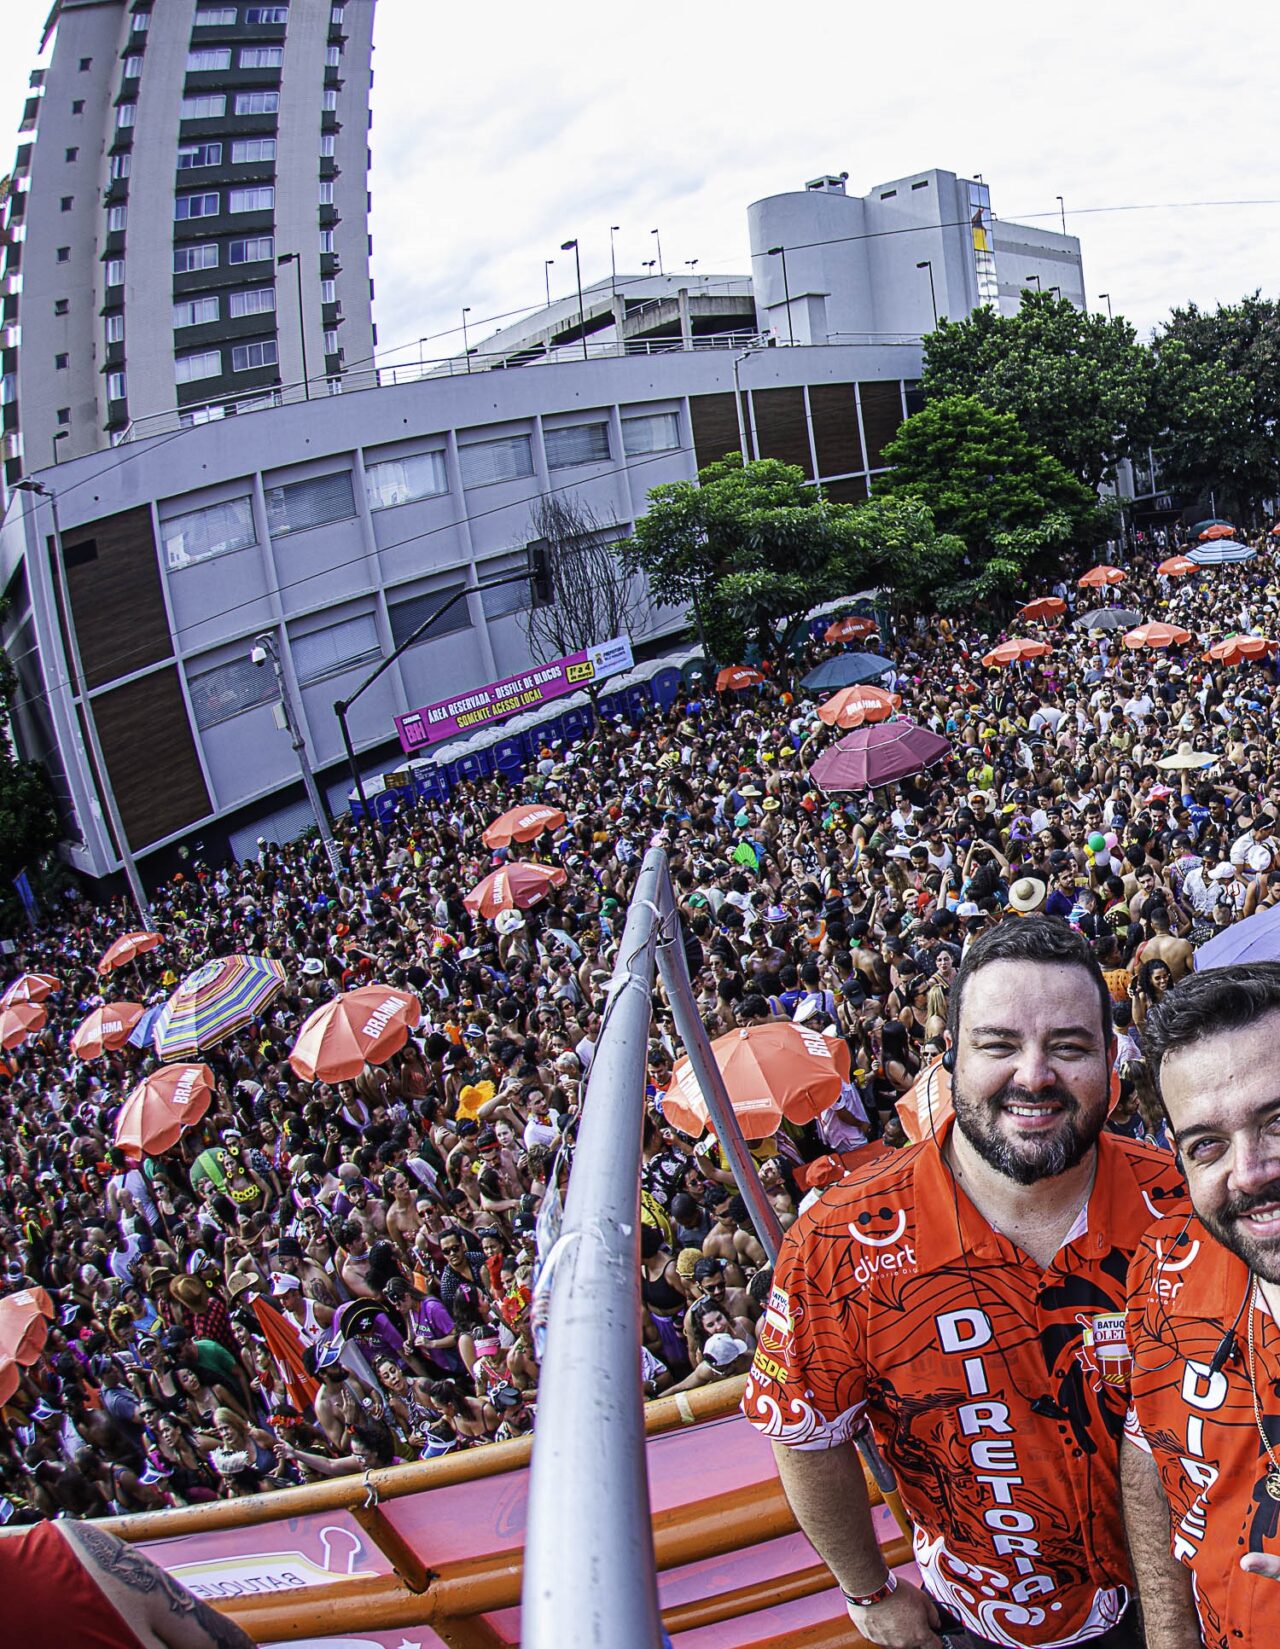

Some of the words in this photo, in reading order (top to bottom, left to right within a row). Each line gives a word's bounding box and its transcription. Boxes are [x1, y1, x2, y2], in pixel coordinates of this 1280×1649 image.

[584, 662, 591, 671] 4
[428, 708, 448, 724] ÁREA
[449, 691, 491, 716] RESERVADA
[495, 681, 523, 699] DESFILE
[523, 676, 534, 689] DE
[534, 666, 562, 686] BLOCOS
[456, 708, 492, 728] SOMENTE
[492, 696, 520, 716] ACESSO
[521, 687, 543, 706] LOCAL
[845, 699, 882, 715] BRAHMA
[404, 720, 427, 745] BH
[518, 809, 555, 828] BRAHMA
[855, 1244, 917, 1284] divert
[1097, 1320, 1125, 1330] BATUQ
[750, 1362, 772, 1388] 2017
[754, 1349, 789, 1384] ESDE
[935, 1307, 1056, 1604] DIRETORIA
